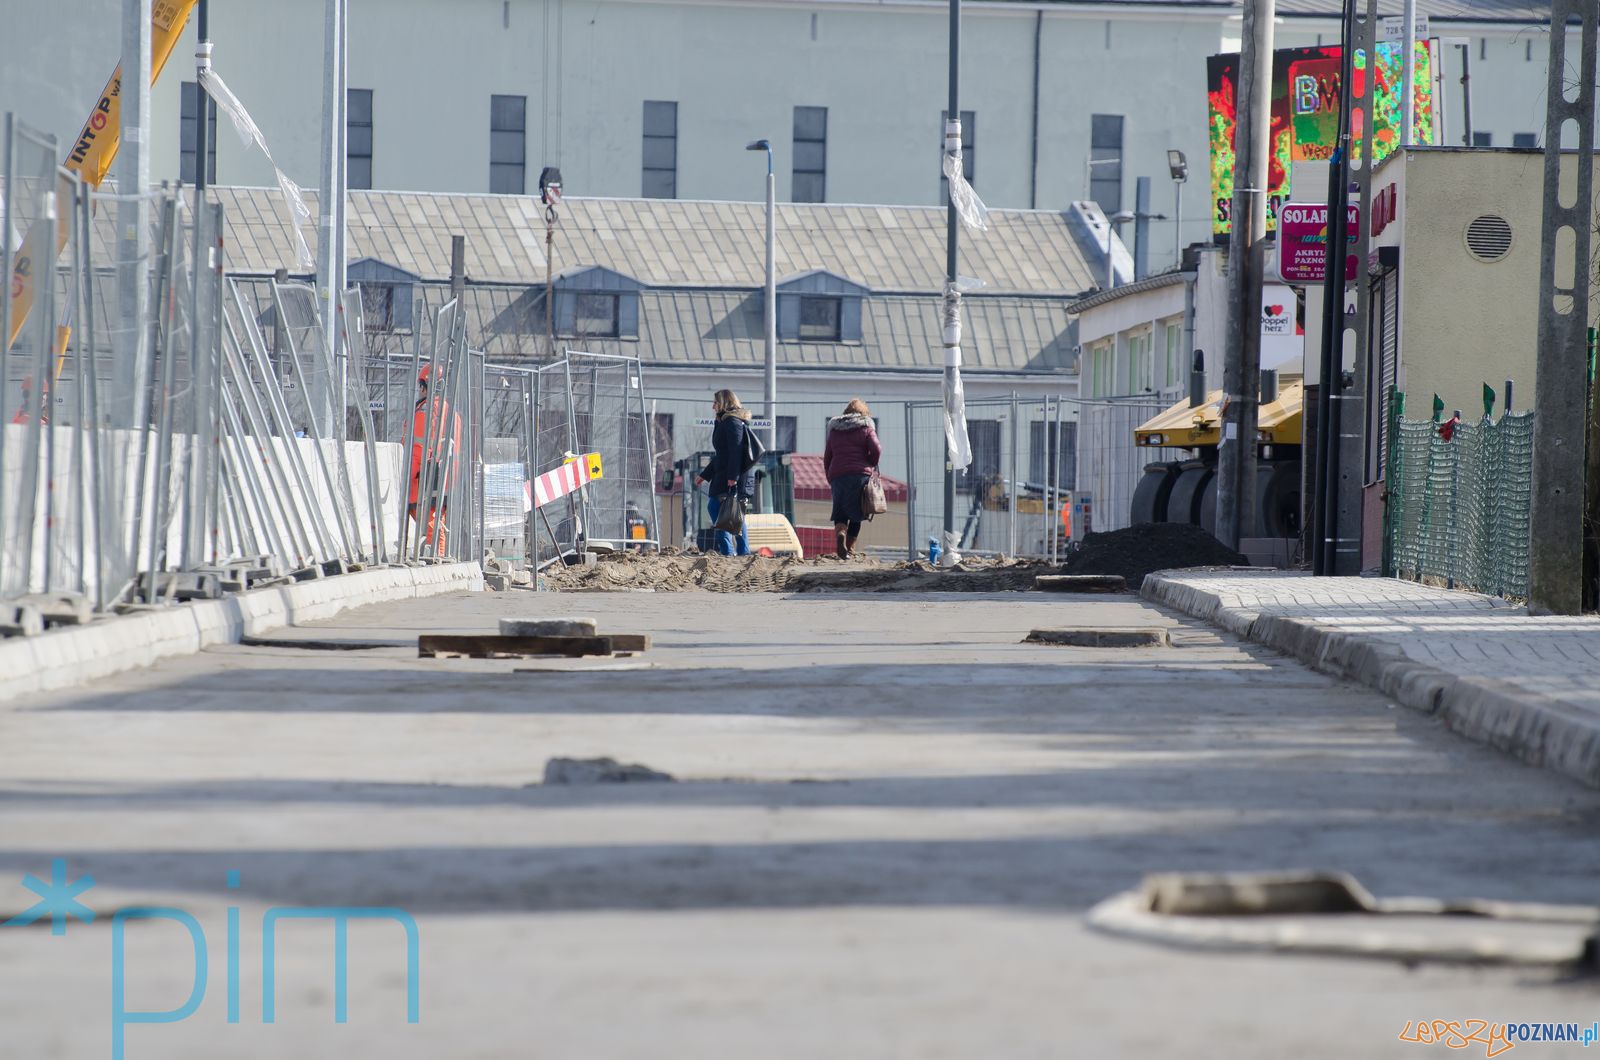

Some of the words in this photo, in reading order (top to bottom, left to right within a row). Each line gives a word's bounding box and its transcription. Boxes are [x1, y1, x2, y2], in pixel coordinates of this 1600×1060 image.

[71, 96, 112, 165] INTOP
[1283, 209, 1357, 224] SOLARM
[1295, 249, 1327, 257] AKRYL
[1264, 325, 1283, 333] herz
